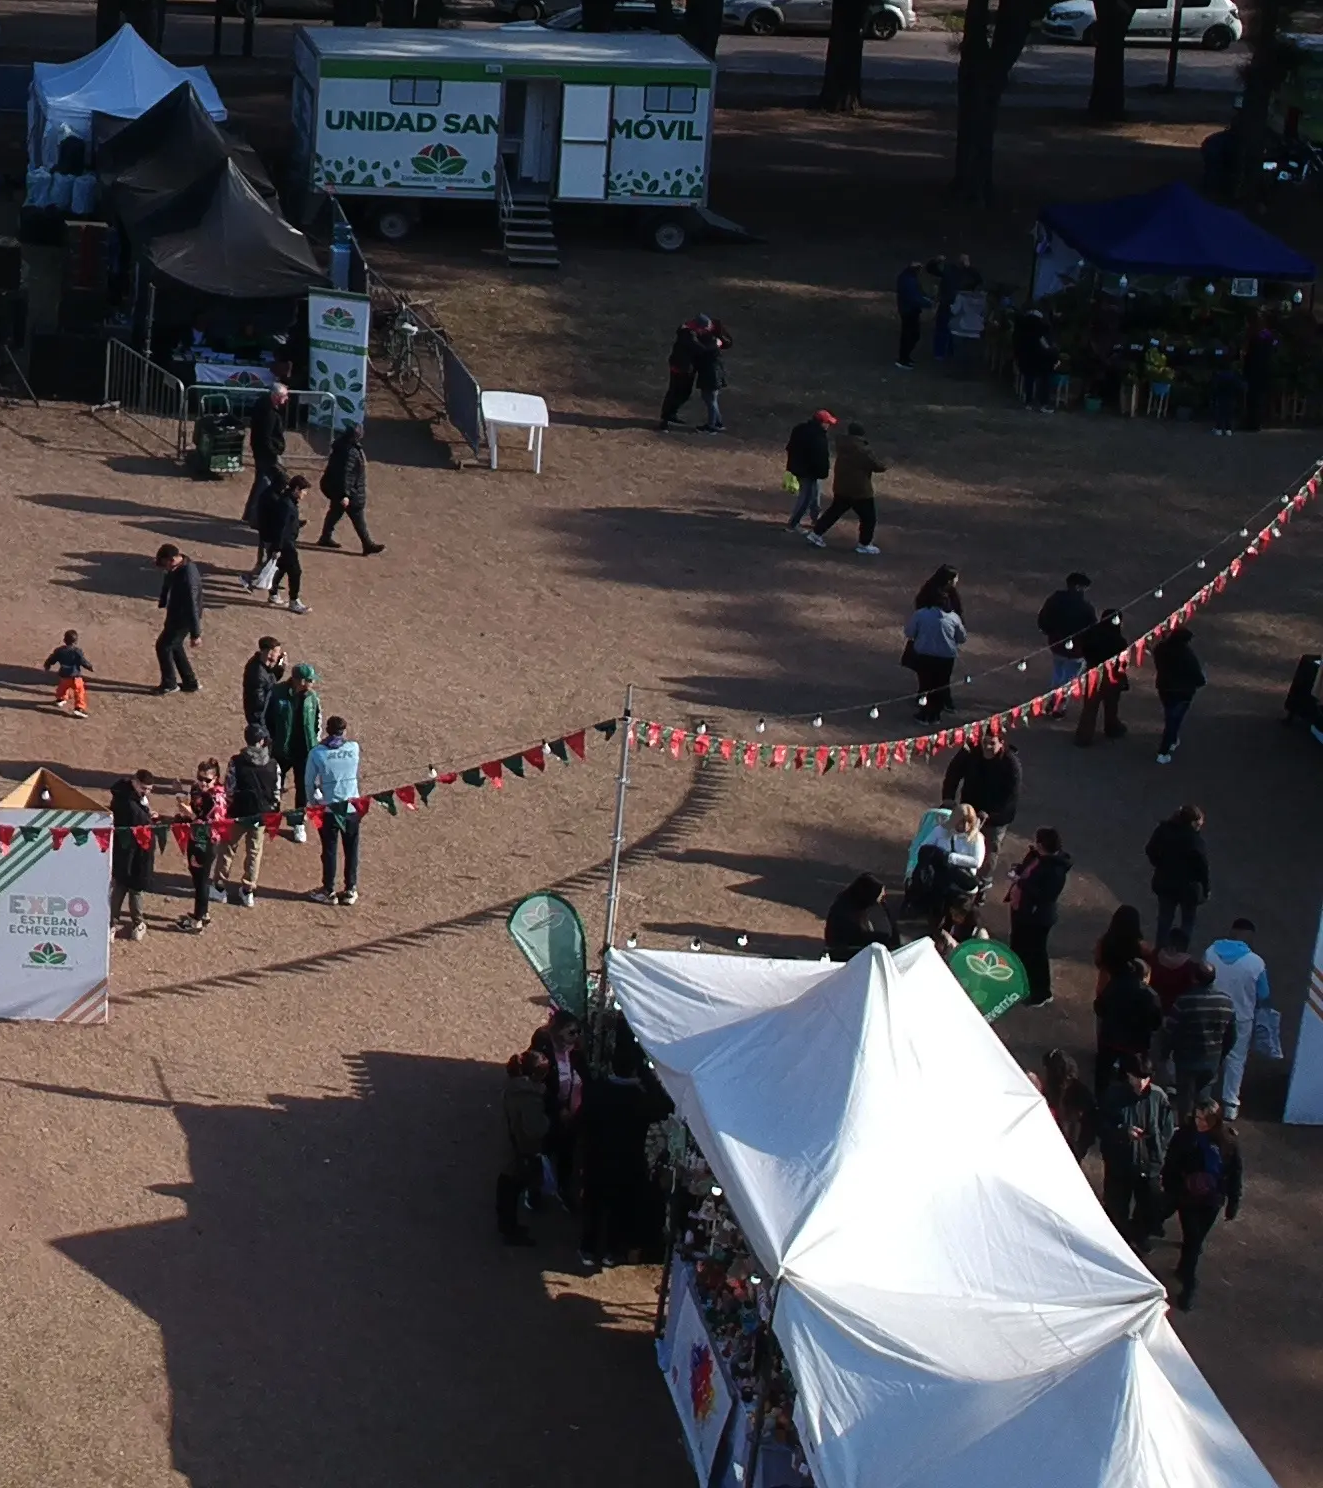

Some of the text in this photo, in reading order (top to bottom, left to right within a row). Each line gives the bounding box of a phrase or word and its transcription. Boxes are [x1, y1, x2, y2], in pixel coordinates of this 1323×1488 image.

[325, 109, 437, 133] UNIDAD
[612, 114, 703, 141] MÓVIL
[8, 894, 90, 918] EXPO
[20, 915, 78, 927] ESTEBAN
[9, 924, 89, 938] ECHEVERRÍA
